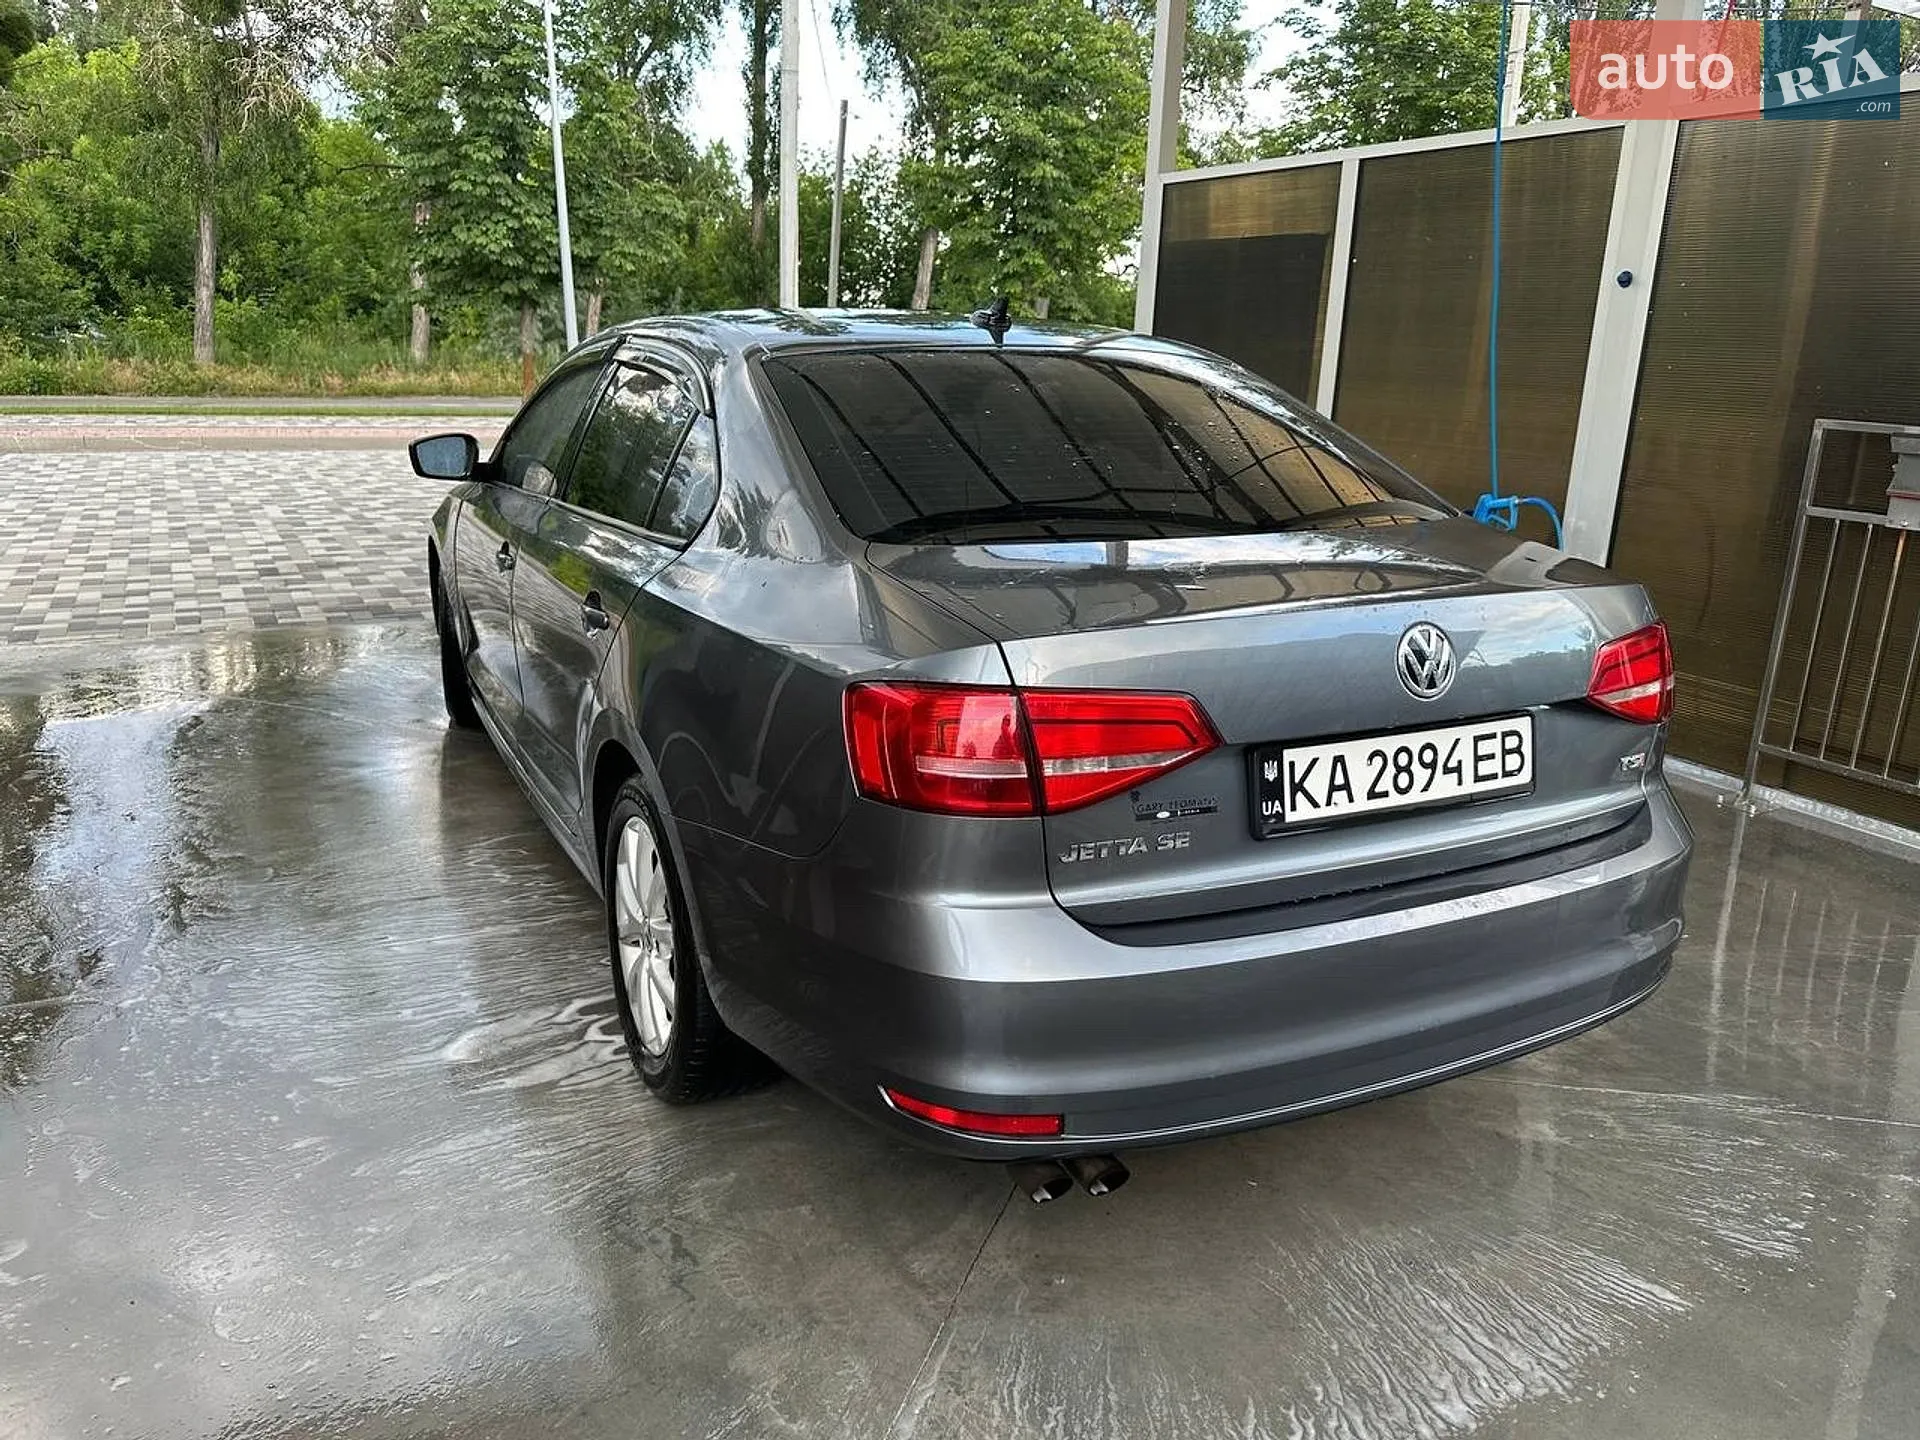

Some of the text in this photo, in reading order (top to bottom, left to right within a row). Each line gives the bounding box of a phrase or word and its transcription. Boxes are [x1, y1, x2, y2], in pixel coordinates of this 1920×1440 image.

[1288, 730, 1525, 811] KA 2894 EB
[1262, 798, 1283, 816] UA
[1059, 831, 1191, 863] JETTA SE
